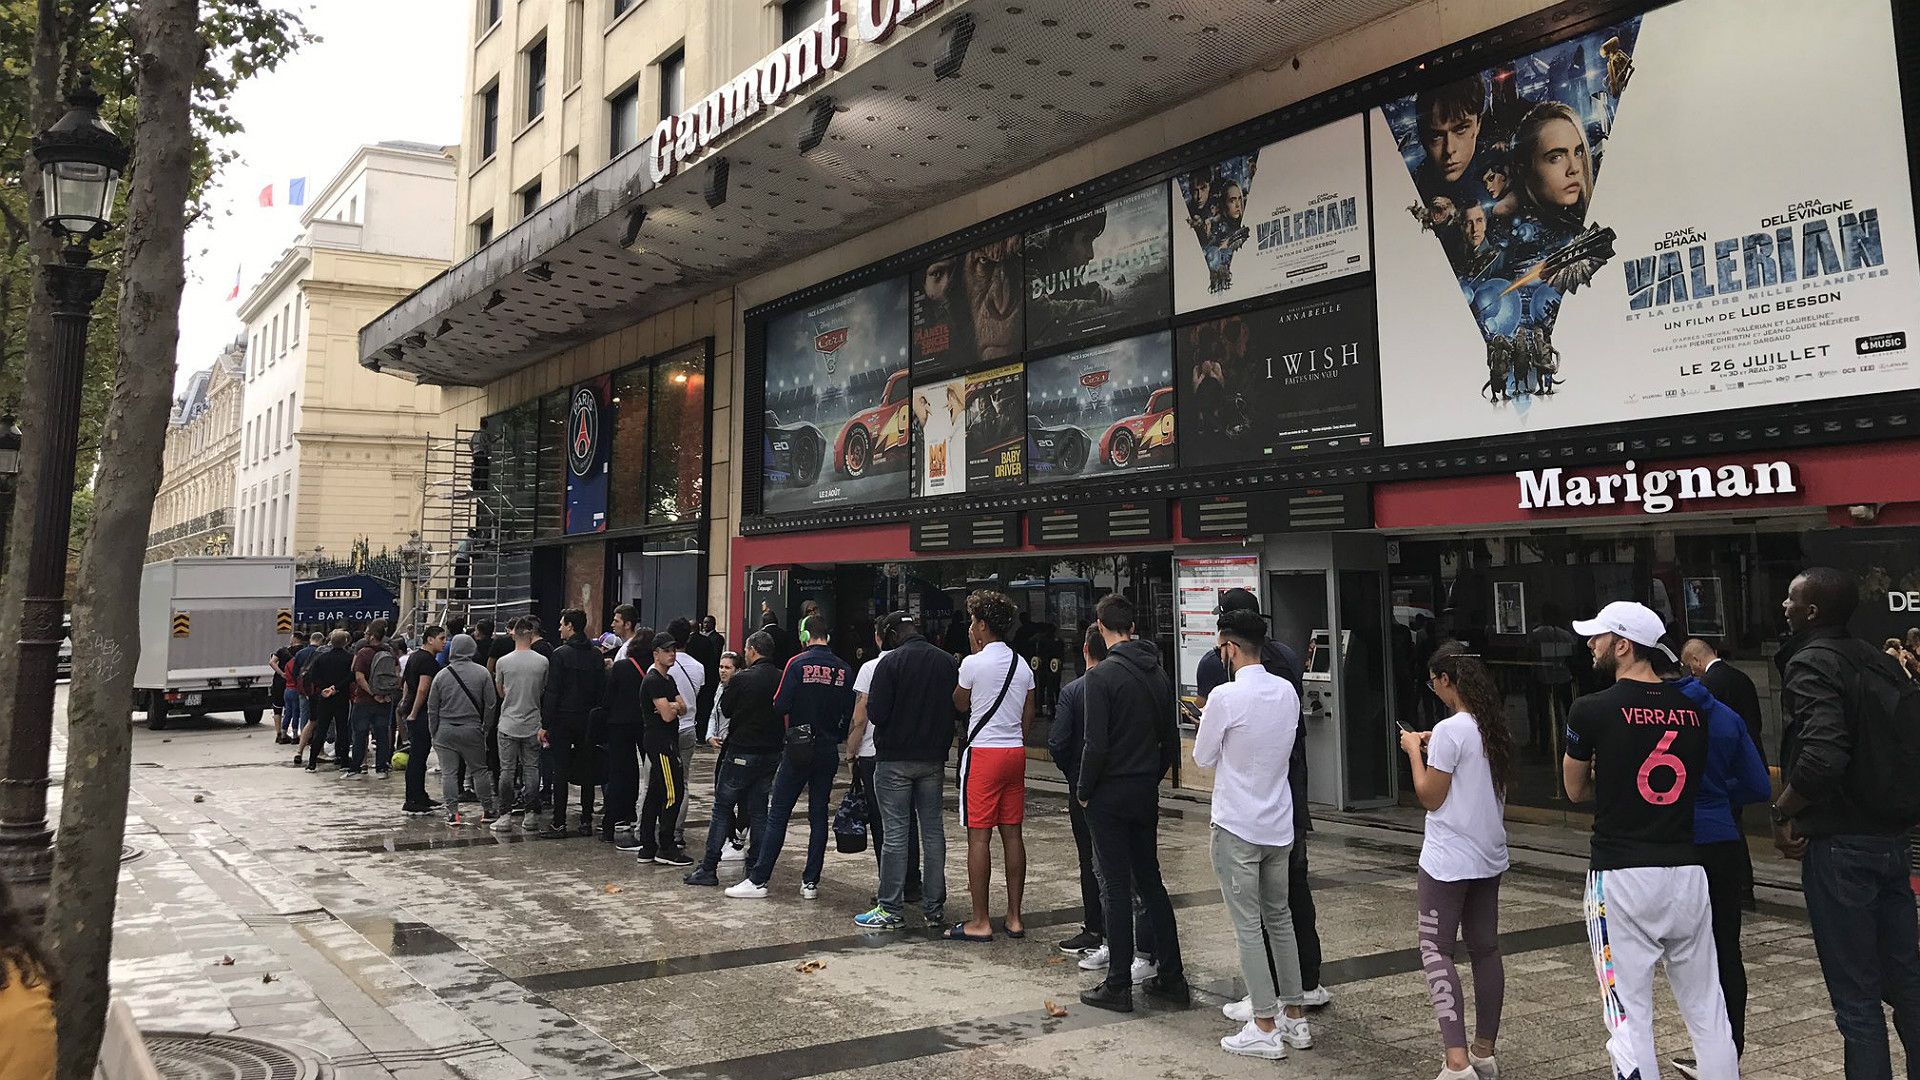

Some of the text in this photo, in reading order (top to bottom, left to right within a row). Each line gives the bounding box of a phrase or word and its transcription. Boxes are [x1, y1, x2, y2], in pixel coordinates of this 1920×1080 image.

[651, 0, 841, 183] Gaumont
[1761, 200, 1854, 228] DELEVINGNE
[1788, 198, 1822, 212] CARA
[1256, 197, 1357, 250] VALERIAN
[1665, 226, 1695, 239] DANE
[1654, 232, 1707, 251] DEHAAN
[1623, 208, 1885, 311] VALERIAN
[1279, 304, 1341, 323] ANNABELLE
[1626, 312, 1641, 322] ET
[1649, 308, 1664, 318] LA
[1748, 286, 1793, 300] MILLE
[1664, 291, 1842, 331] UN FILM DE LUC BESSON
[1689, 338, 1715, 348] PIERRE
[1716, 333, 1751, 344] CHRISTIN
[1763, 322, 1817, 336] JEAN-CLAUDE
[1753, 334, 1791, 345] DARGAUD
[1870, 337, 1901, 349] MUSIC
[1266, 342, 1359, 379] I WISH
[1680, 344, 1831, 377] LE 26 JUILLET
[1776, 363, 1787, 371] 3D
[574, 393, 593, 415] PARIS
[773, 441, 789, 451] 20
[1037, 439, 1054, 447] 20
[1001, 450, 1021, 464] BABY
[995, 463, 1021, 478] DRIVER
[1516, 460, 1796, 513] Marignan
[318, 612, 344, 620] BAR
[355, 610, 390, 619] CAFE
[1621, 707, 1700, 727] VERRATTI
[1637, 731, 1686, 805] 6
